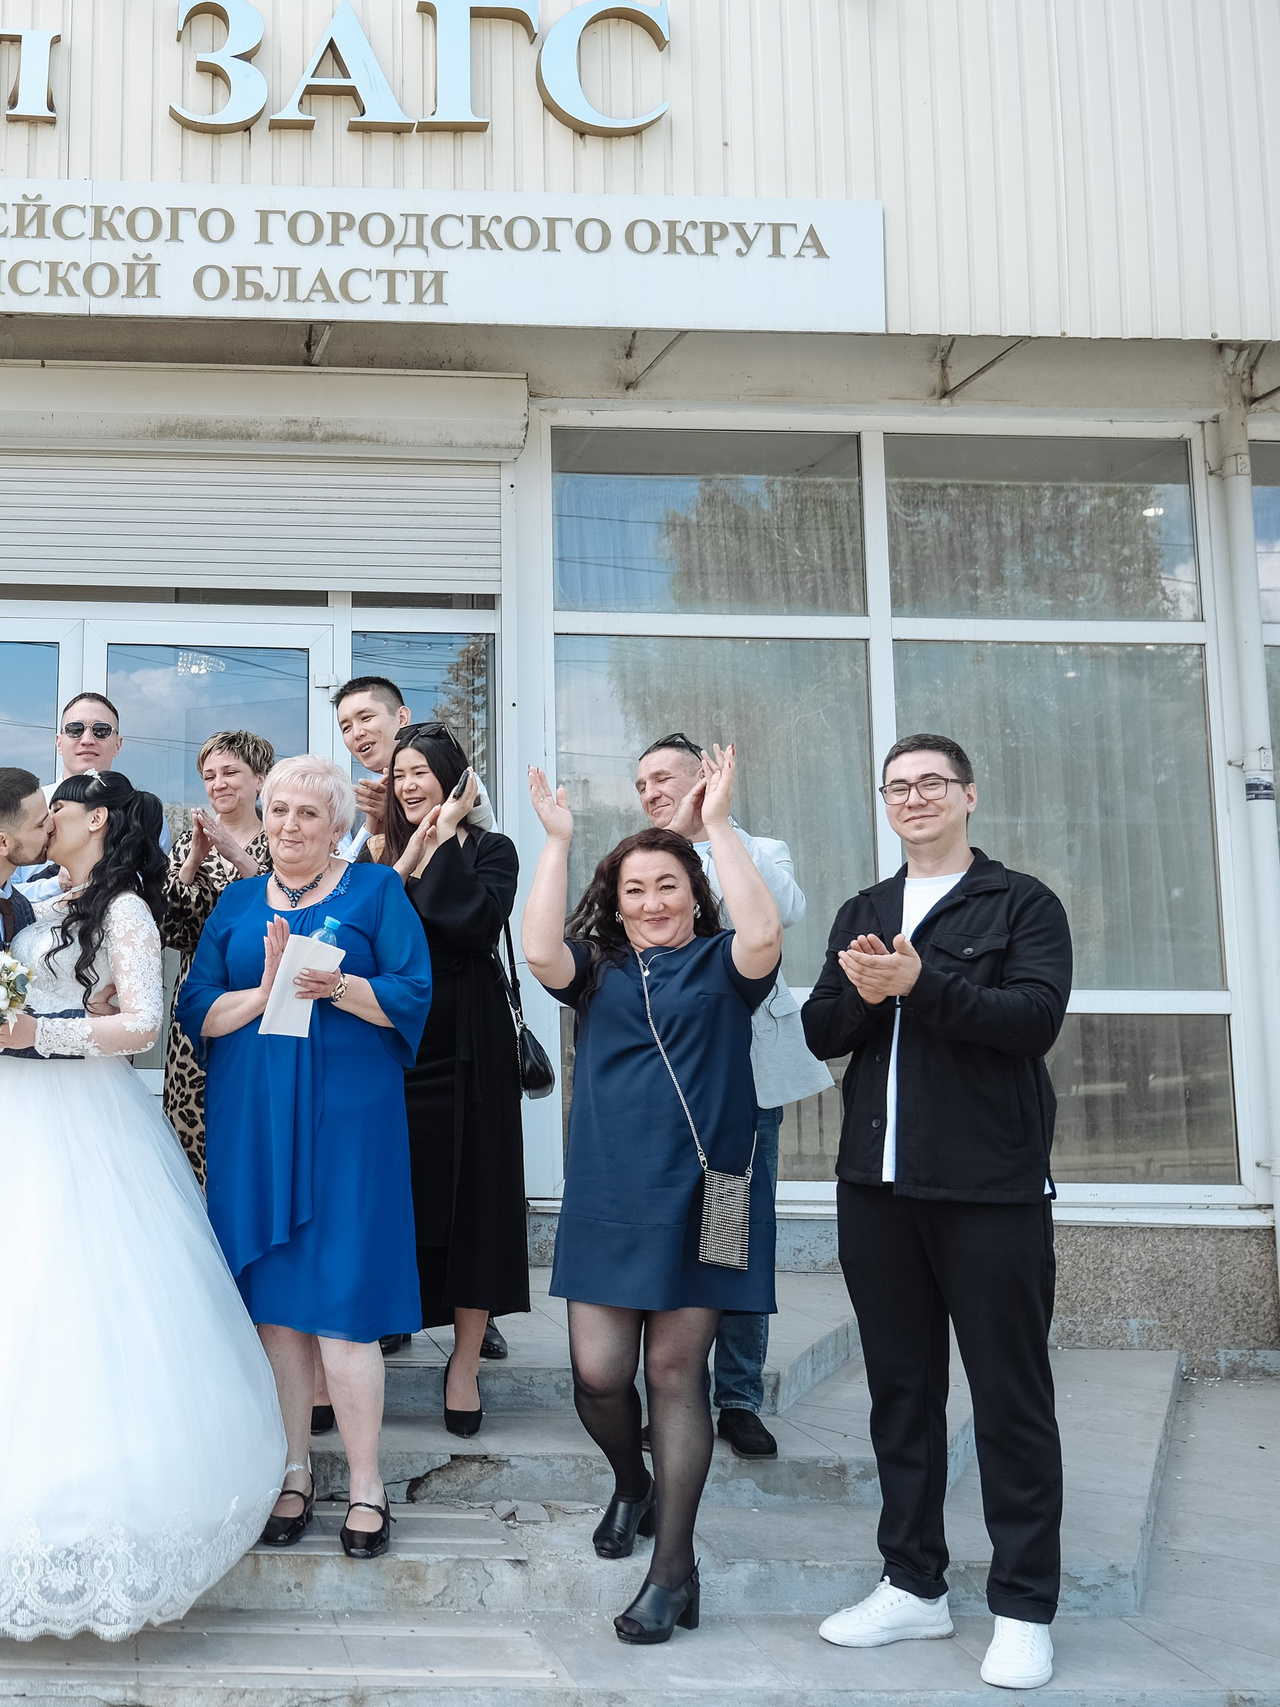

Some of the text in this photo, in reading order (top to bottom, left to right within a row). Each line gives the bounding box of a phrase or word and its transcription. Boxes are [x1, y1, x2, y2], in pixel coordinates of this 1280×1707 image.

[170, 0, 673, 137] ЗАГС
[256, 207, 612, 257] ГОРОДСКОГО
[625, 218, 830, 260] ОКРУГА
[193, 265, 449, 307] ОБЛАСТИ
